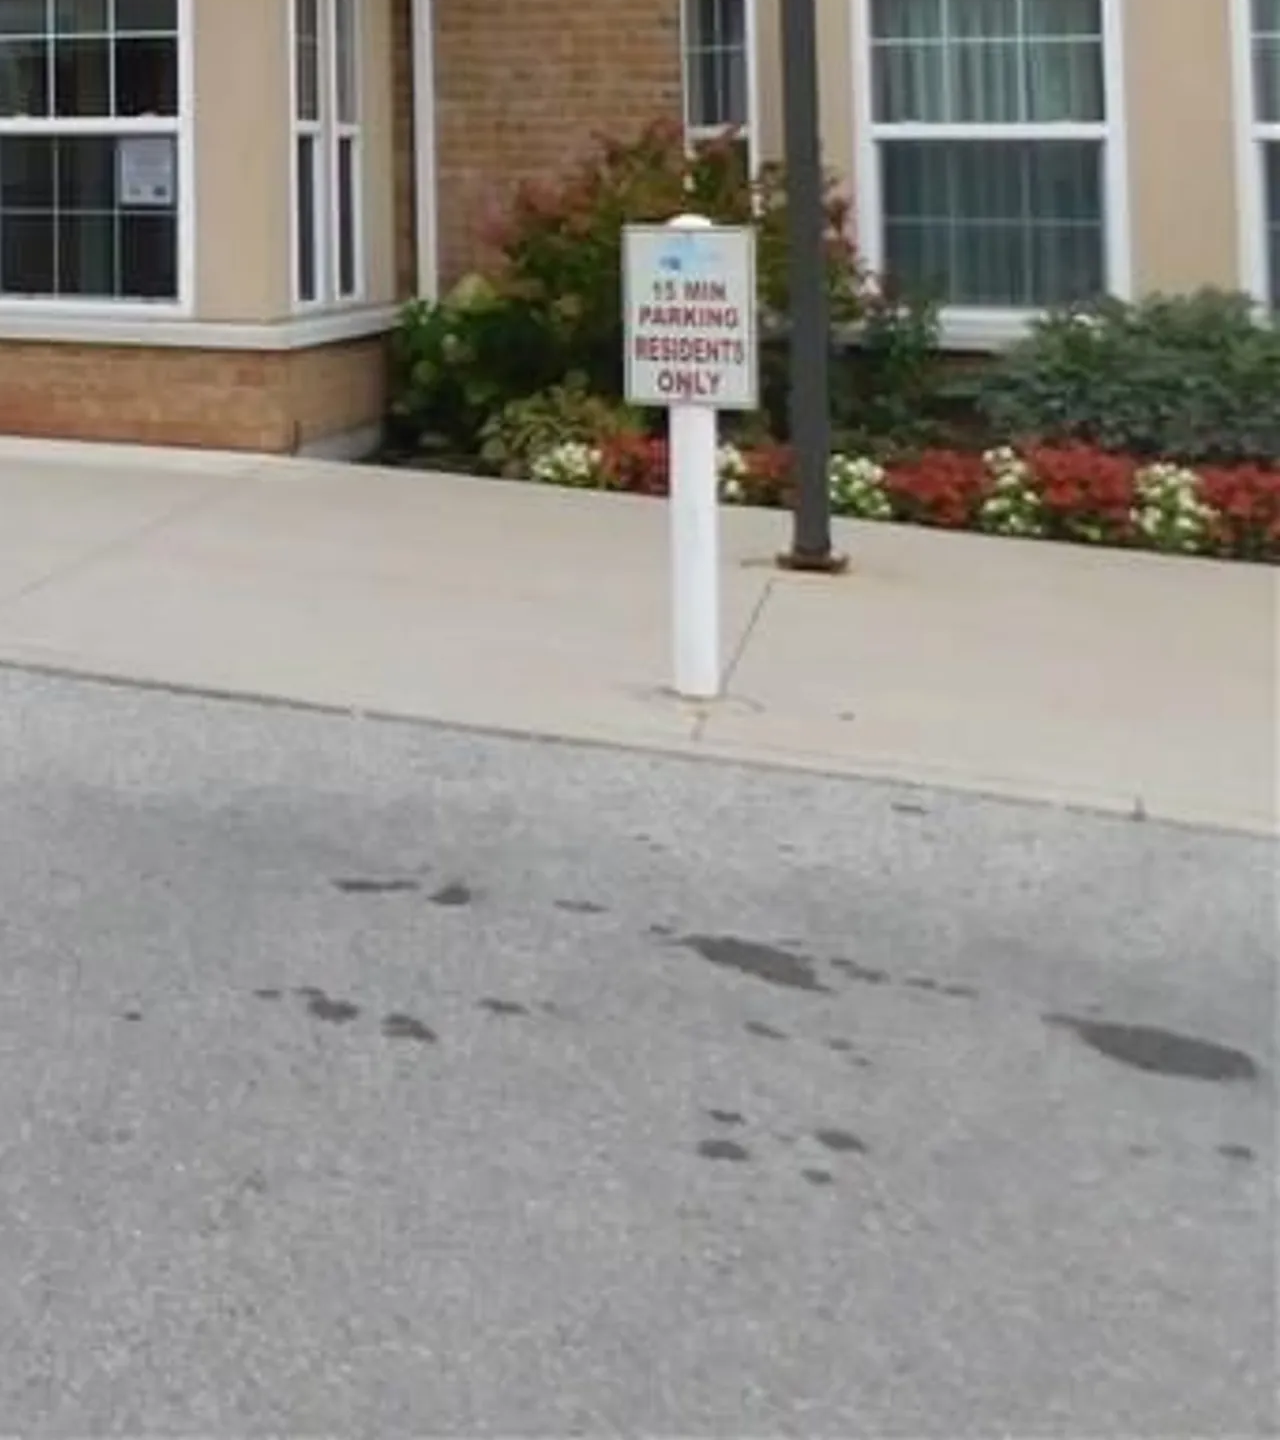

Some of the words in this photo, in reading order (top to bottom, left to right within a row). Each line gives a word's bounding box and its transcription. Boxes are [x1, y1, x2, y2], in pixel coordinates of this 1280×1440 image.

[652, 279, 677, 302] 15
[683, 279, 727, 302] MIN
[637, 305, 740, 330] PARKING
[634, 335, 745, 365] RESIDENTS
[657, 369, 721, 395] ONLY
